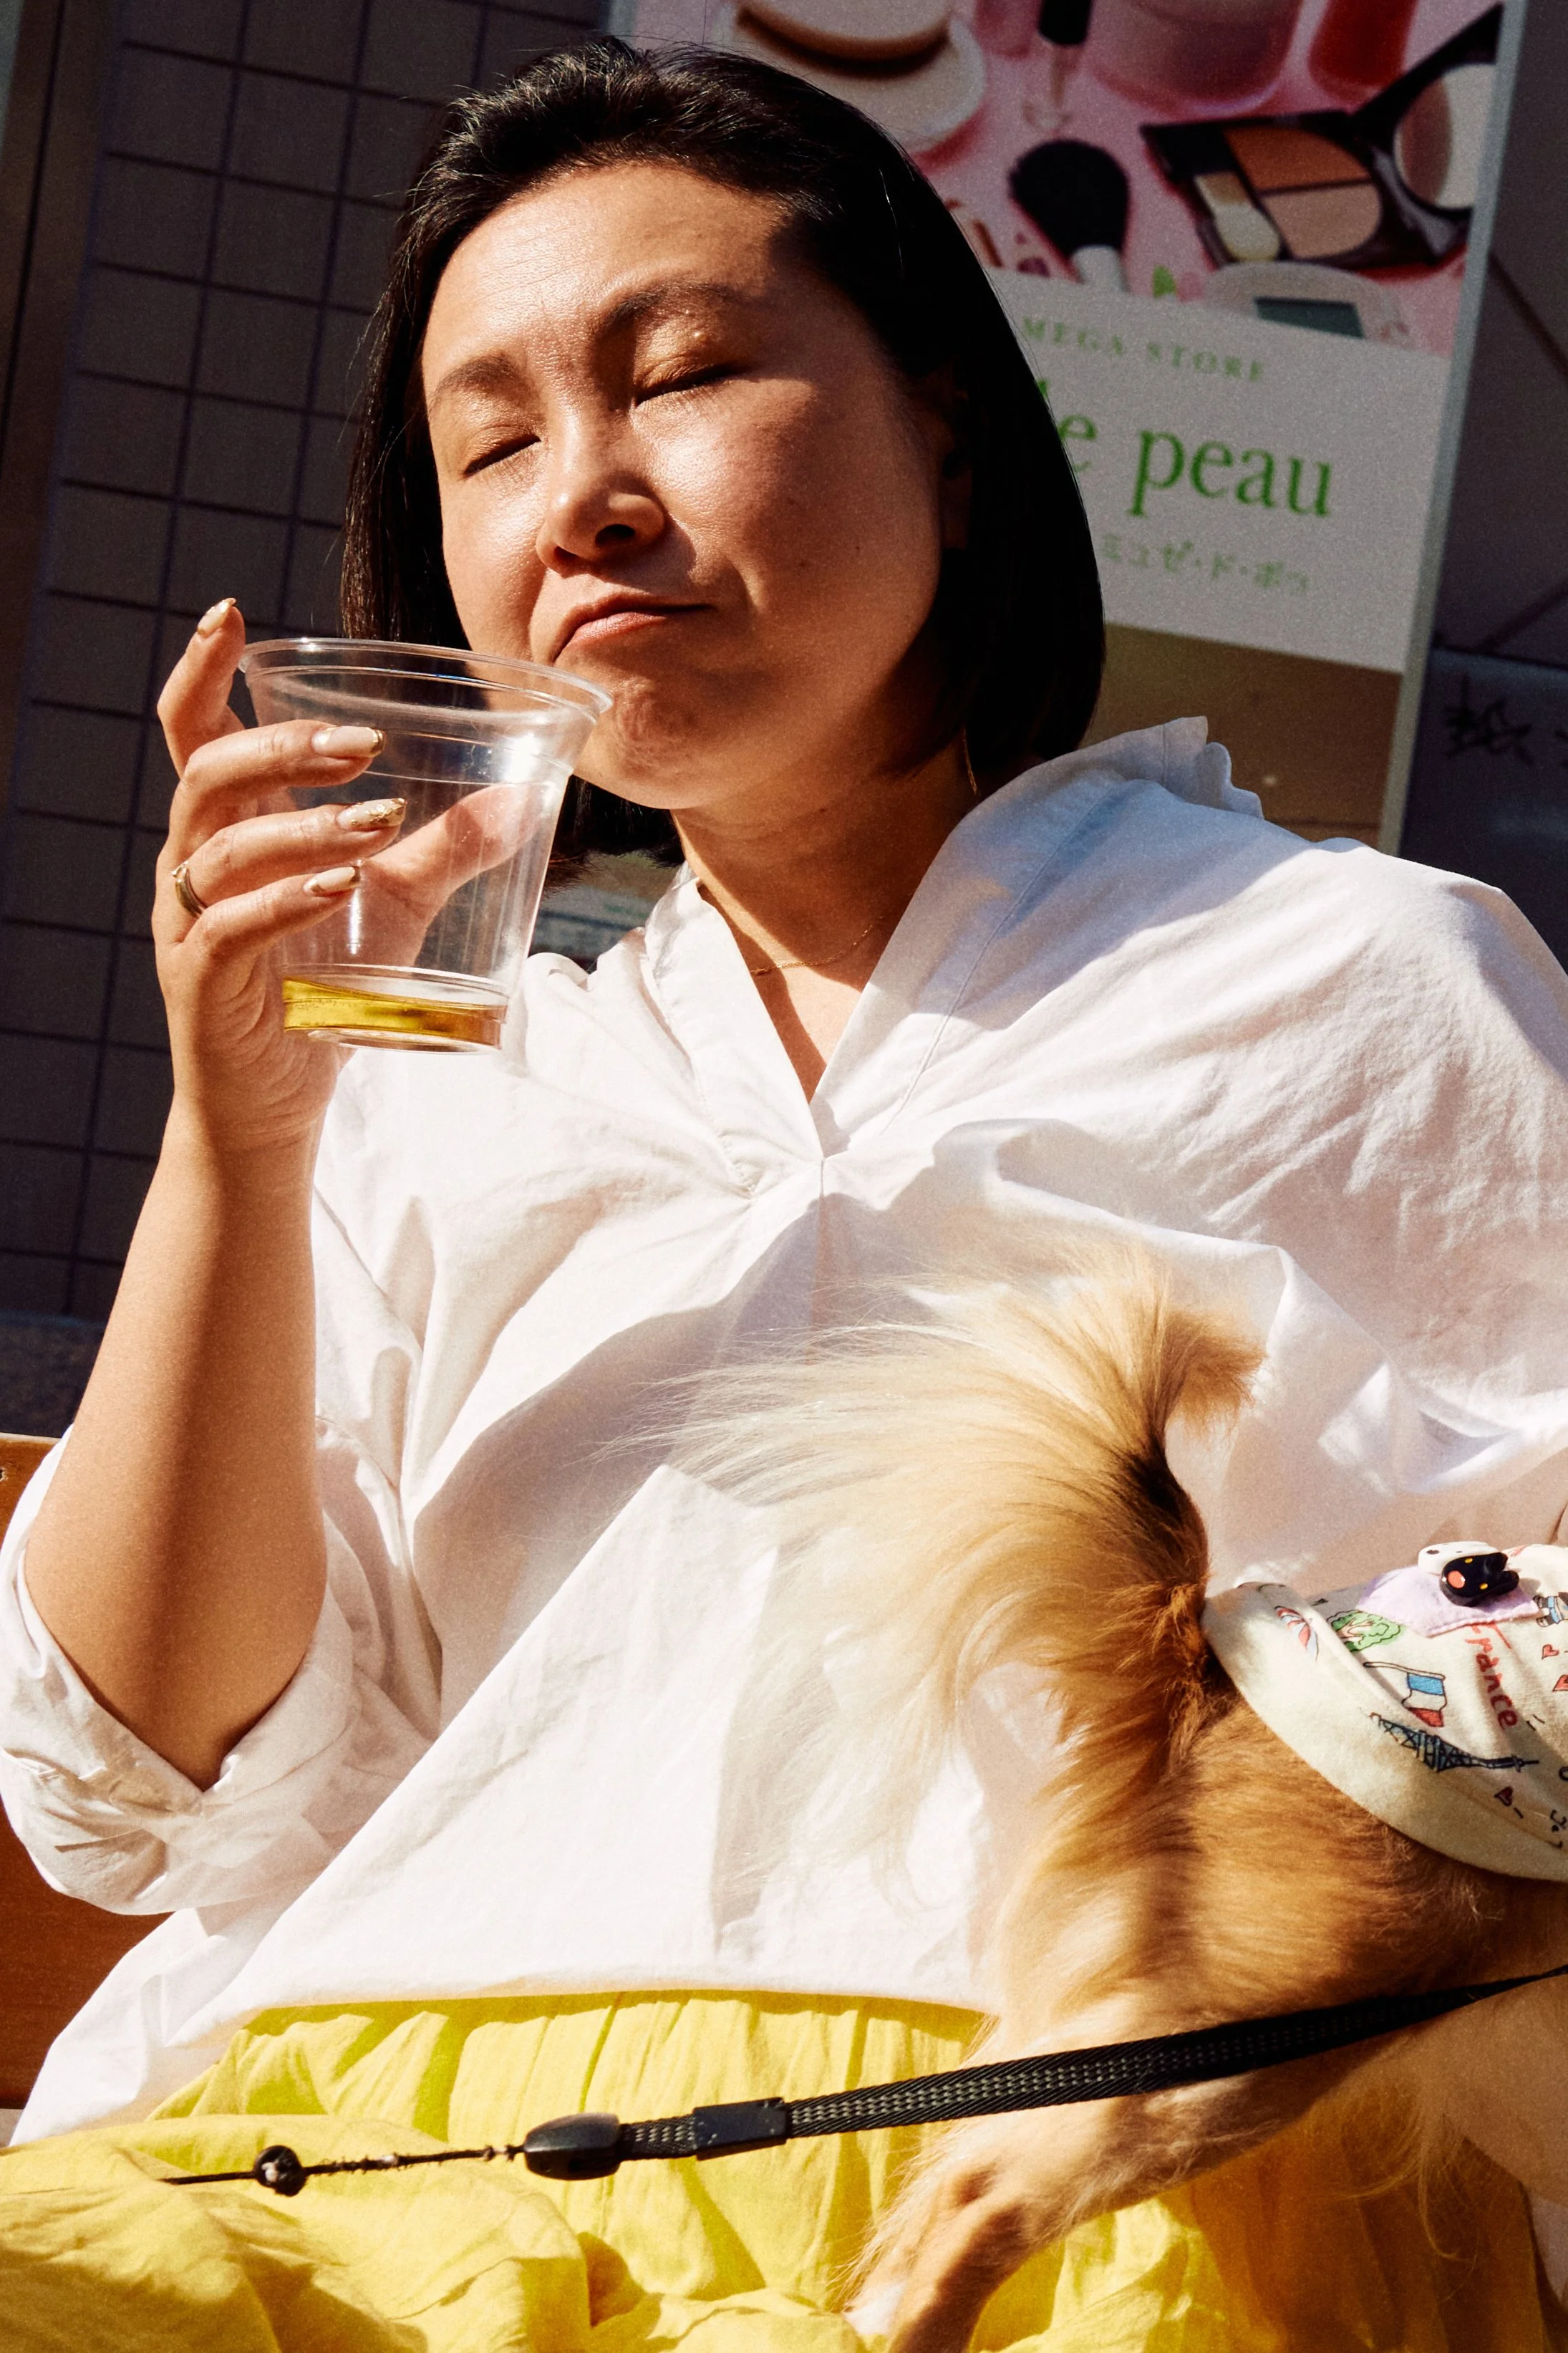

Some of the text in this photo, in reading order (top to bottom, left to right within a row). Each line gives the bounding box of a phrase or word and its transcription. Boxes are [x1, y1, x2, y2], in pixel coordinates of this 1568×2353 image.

[1025, 317, 1264, 382] MEGA STORE
[1128, 430, 1332, 517] peau
